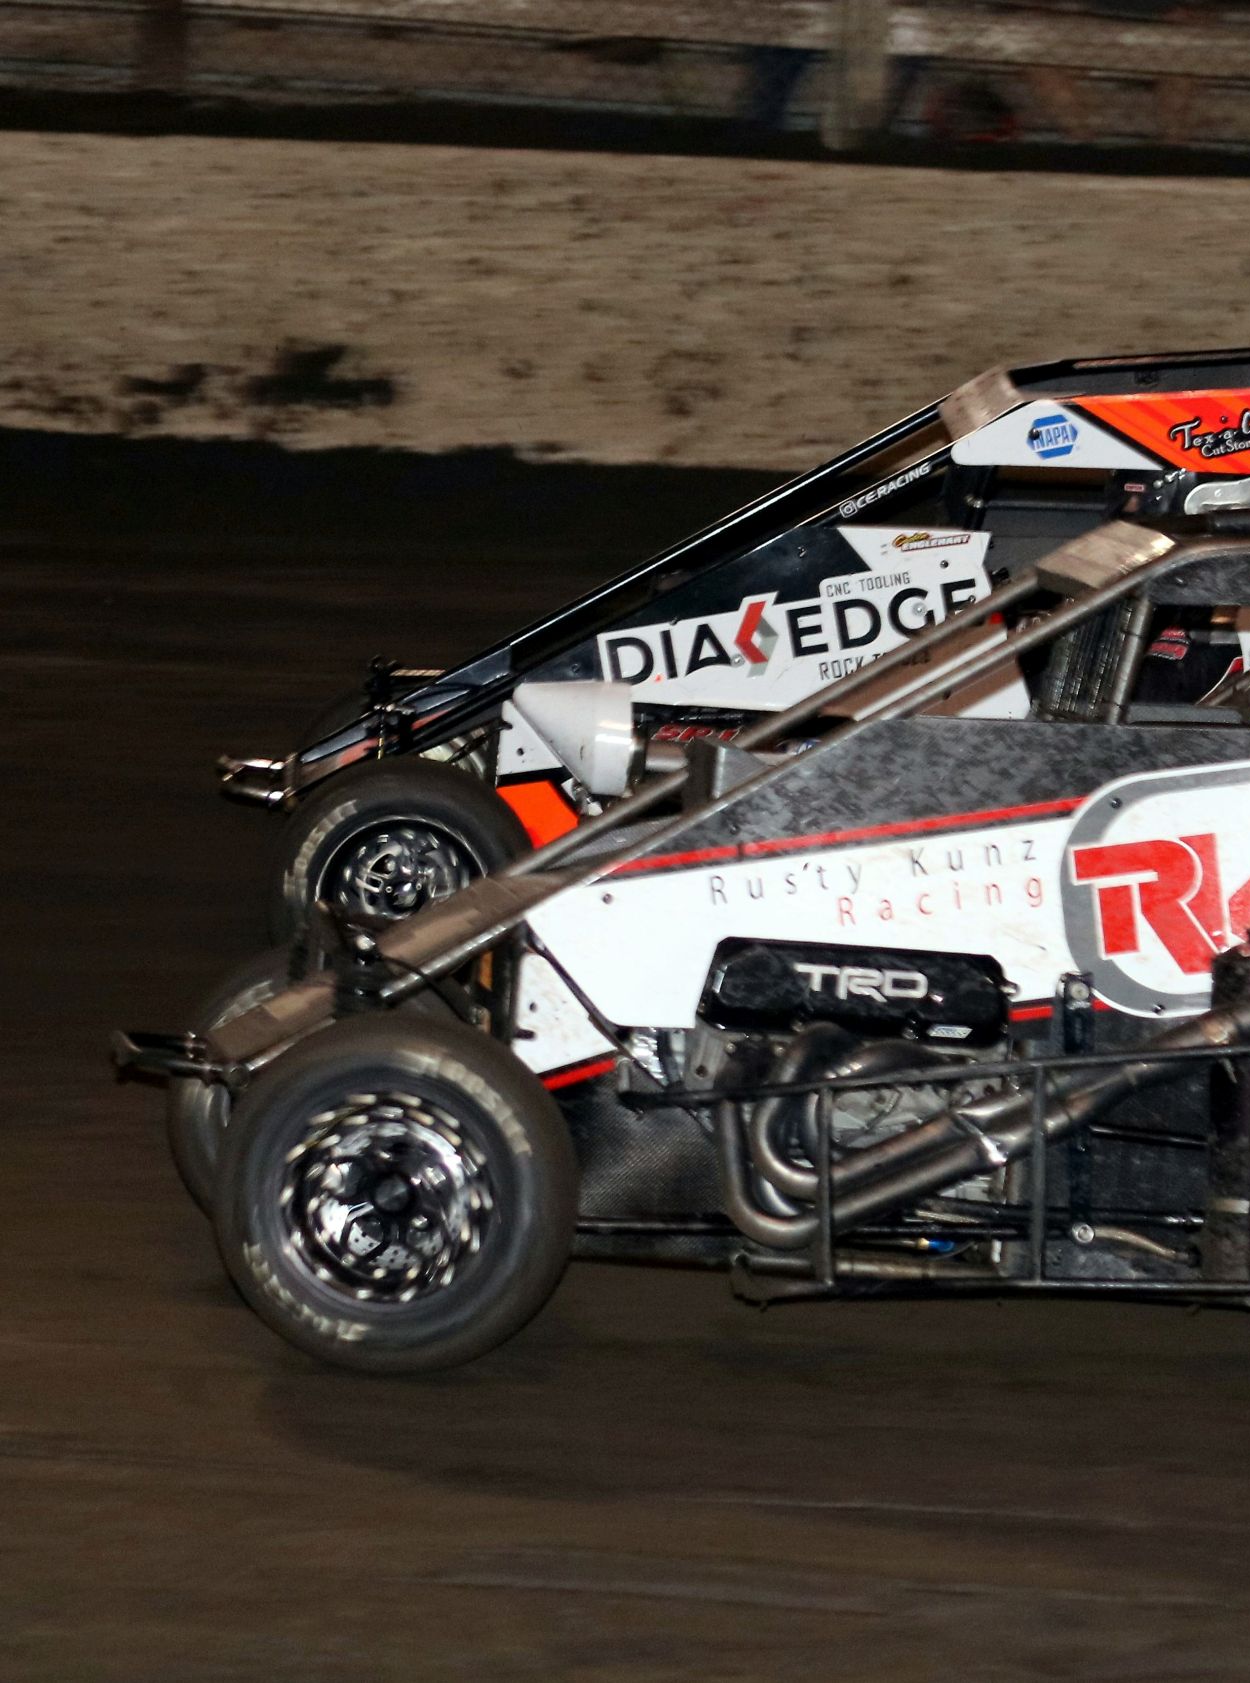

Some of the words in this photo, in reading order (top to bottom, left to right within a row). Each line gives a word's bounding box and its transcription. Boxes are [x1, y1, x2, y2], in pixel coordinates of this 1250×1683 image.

[1034, 424, 1074, 449] NAPA
[826, 581, 851, 598] CNC
[859, 571, 911, 592] TOOLING
[815, 656, 864, 681] ROCK
[911, 839, 1035, 878] Kunz
[836, 876, 1044, 927] Racing
[793, 961, 929, 1003] TRD
